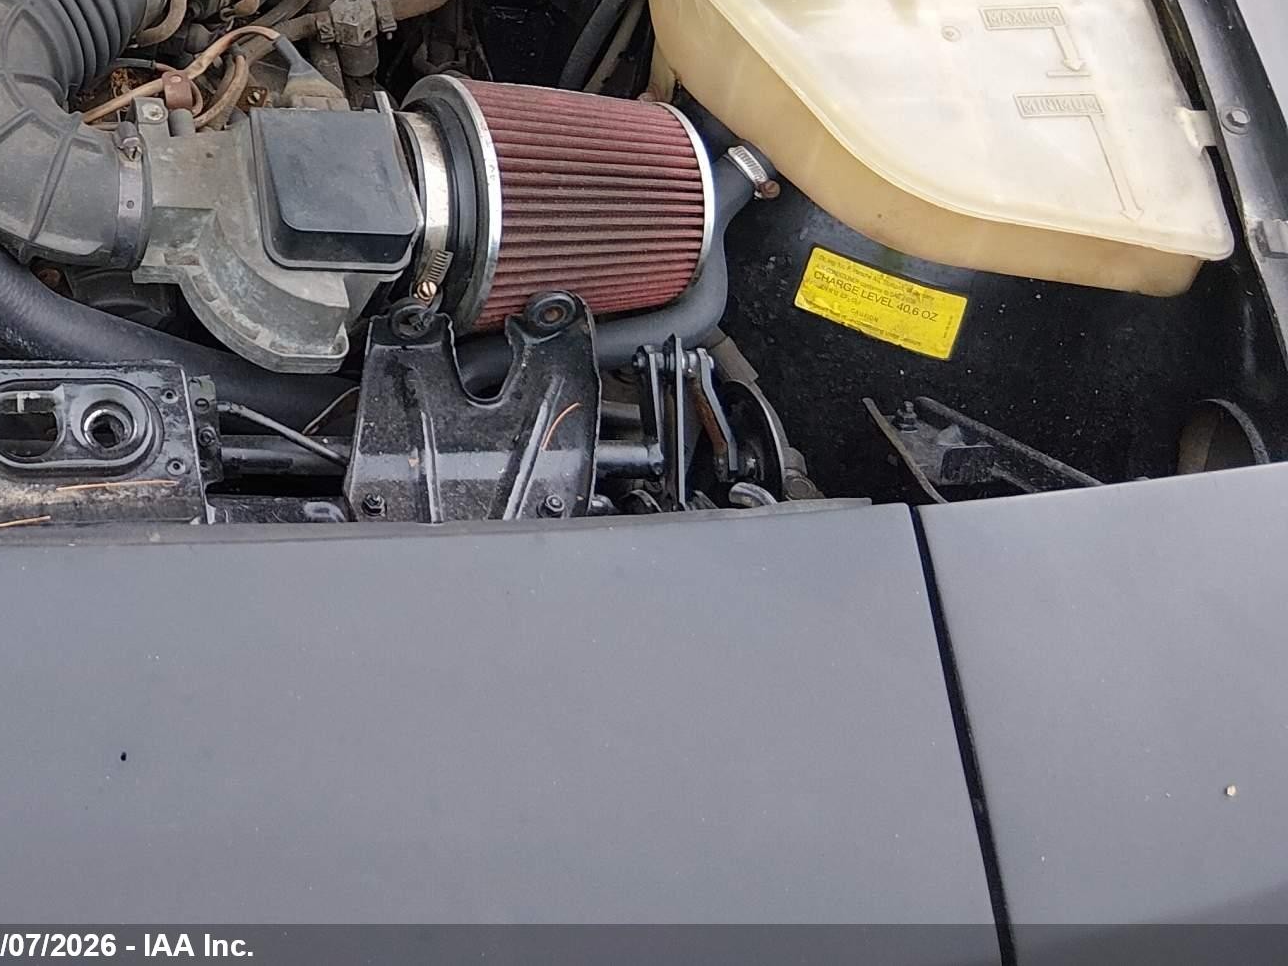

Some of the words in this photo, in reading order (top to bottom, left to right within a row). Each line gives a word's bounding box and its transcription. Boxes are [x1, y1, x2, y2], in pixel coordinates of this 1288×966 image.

[985, 10, 1061, 26] MAXIMUM
[1020, 97, 1098, 114] MINIMUM
[814, 271, 859, 296] CHARGE
[861, 287, 894, 309] LEVEL
[921, 310, 939, 323] OZ
